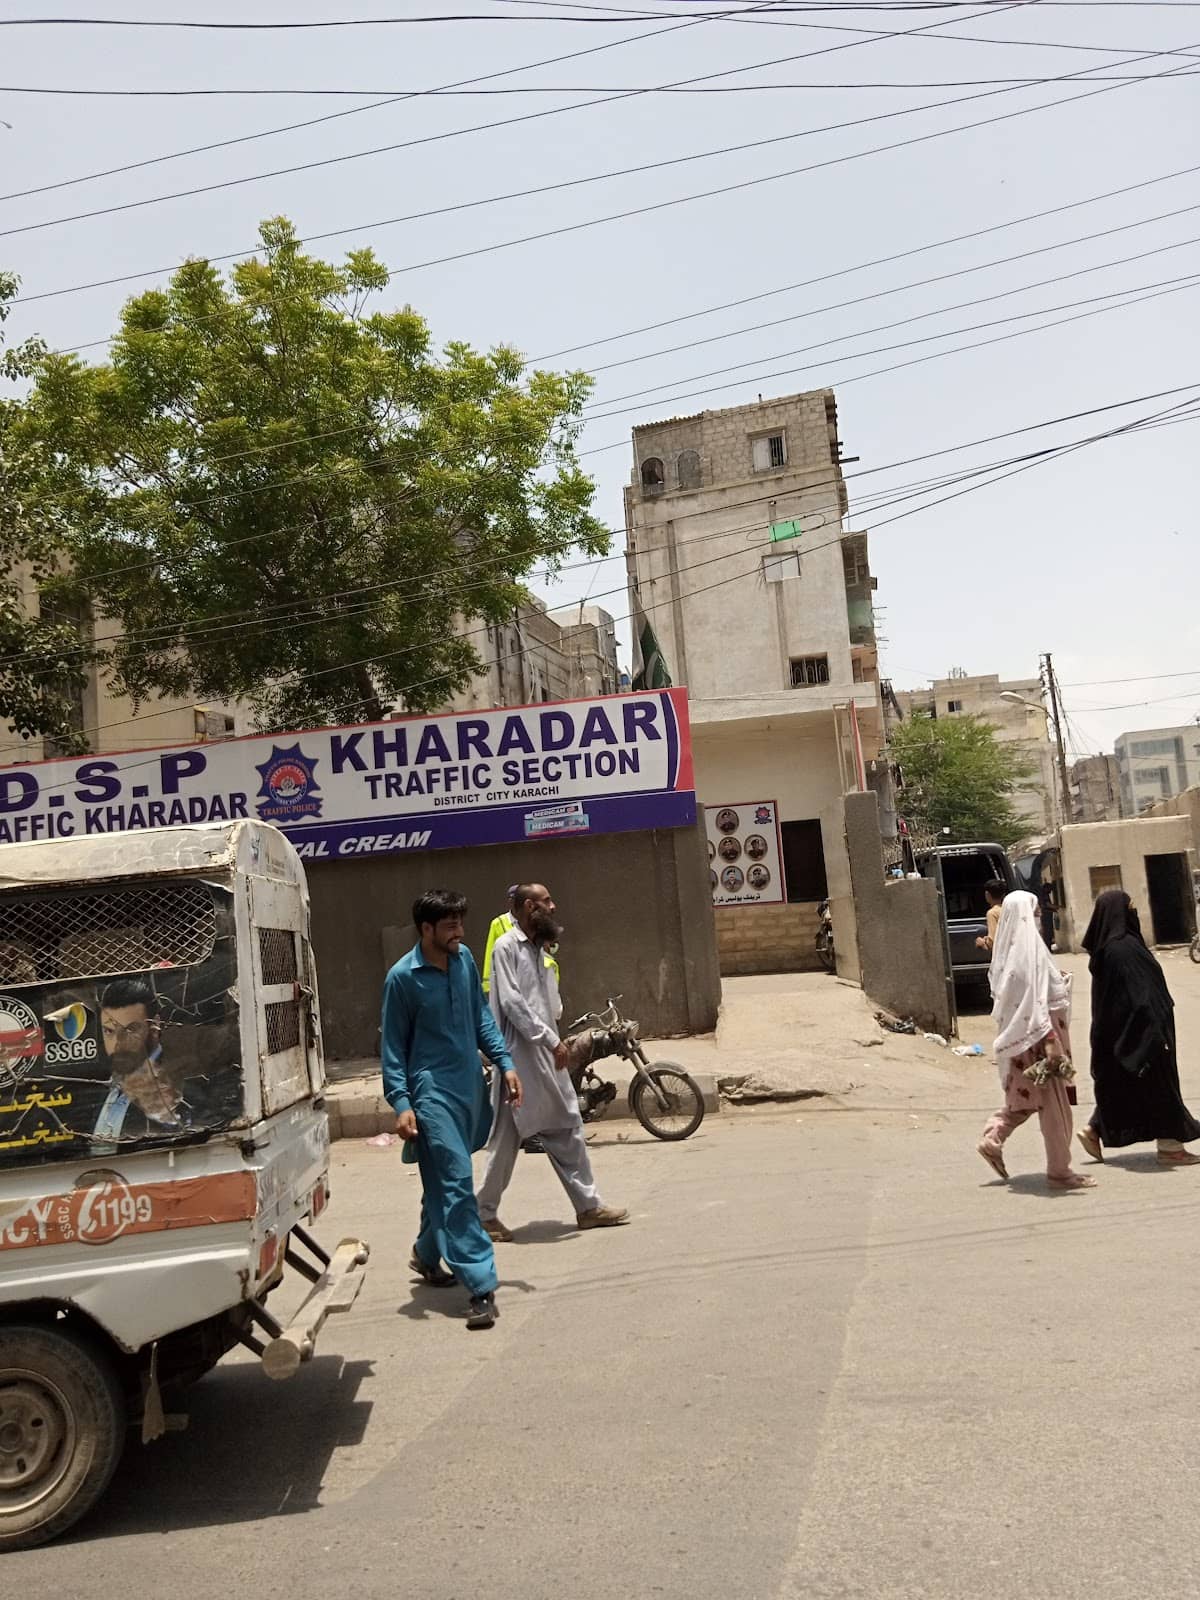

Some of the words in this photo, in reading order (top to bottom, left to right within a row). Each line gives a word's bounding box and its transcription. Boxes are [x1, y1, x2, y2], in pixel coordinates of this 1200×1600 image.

[331, 701, 662, 774] KHARADAR
[365, 764, 492, 799] TRAFFIC
[503, 748, 640, 787] SECTION
[434, 793, 480, 807] DISTRICT
[486, 791, 511, 802] CITY
[513, 785, 559, 799] KARACHI
[85, 792, 248, 835] KHARADAR
[263, 806, 290, 817] TRAFFIC
[291, 803, 317, 814] POLICE
[338, 830, 433, 854] CREAM
[45, 1038, 98, 1063] SSGC
